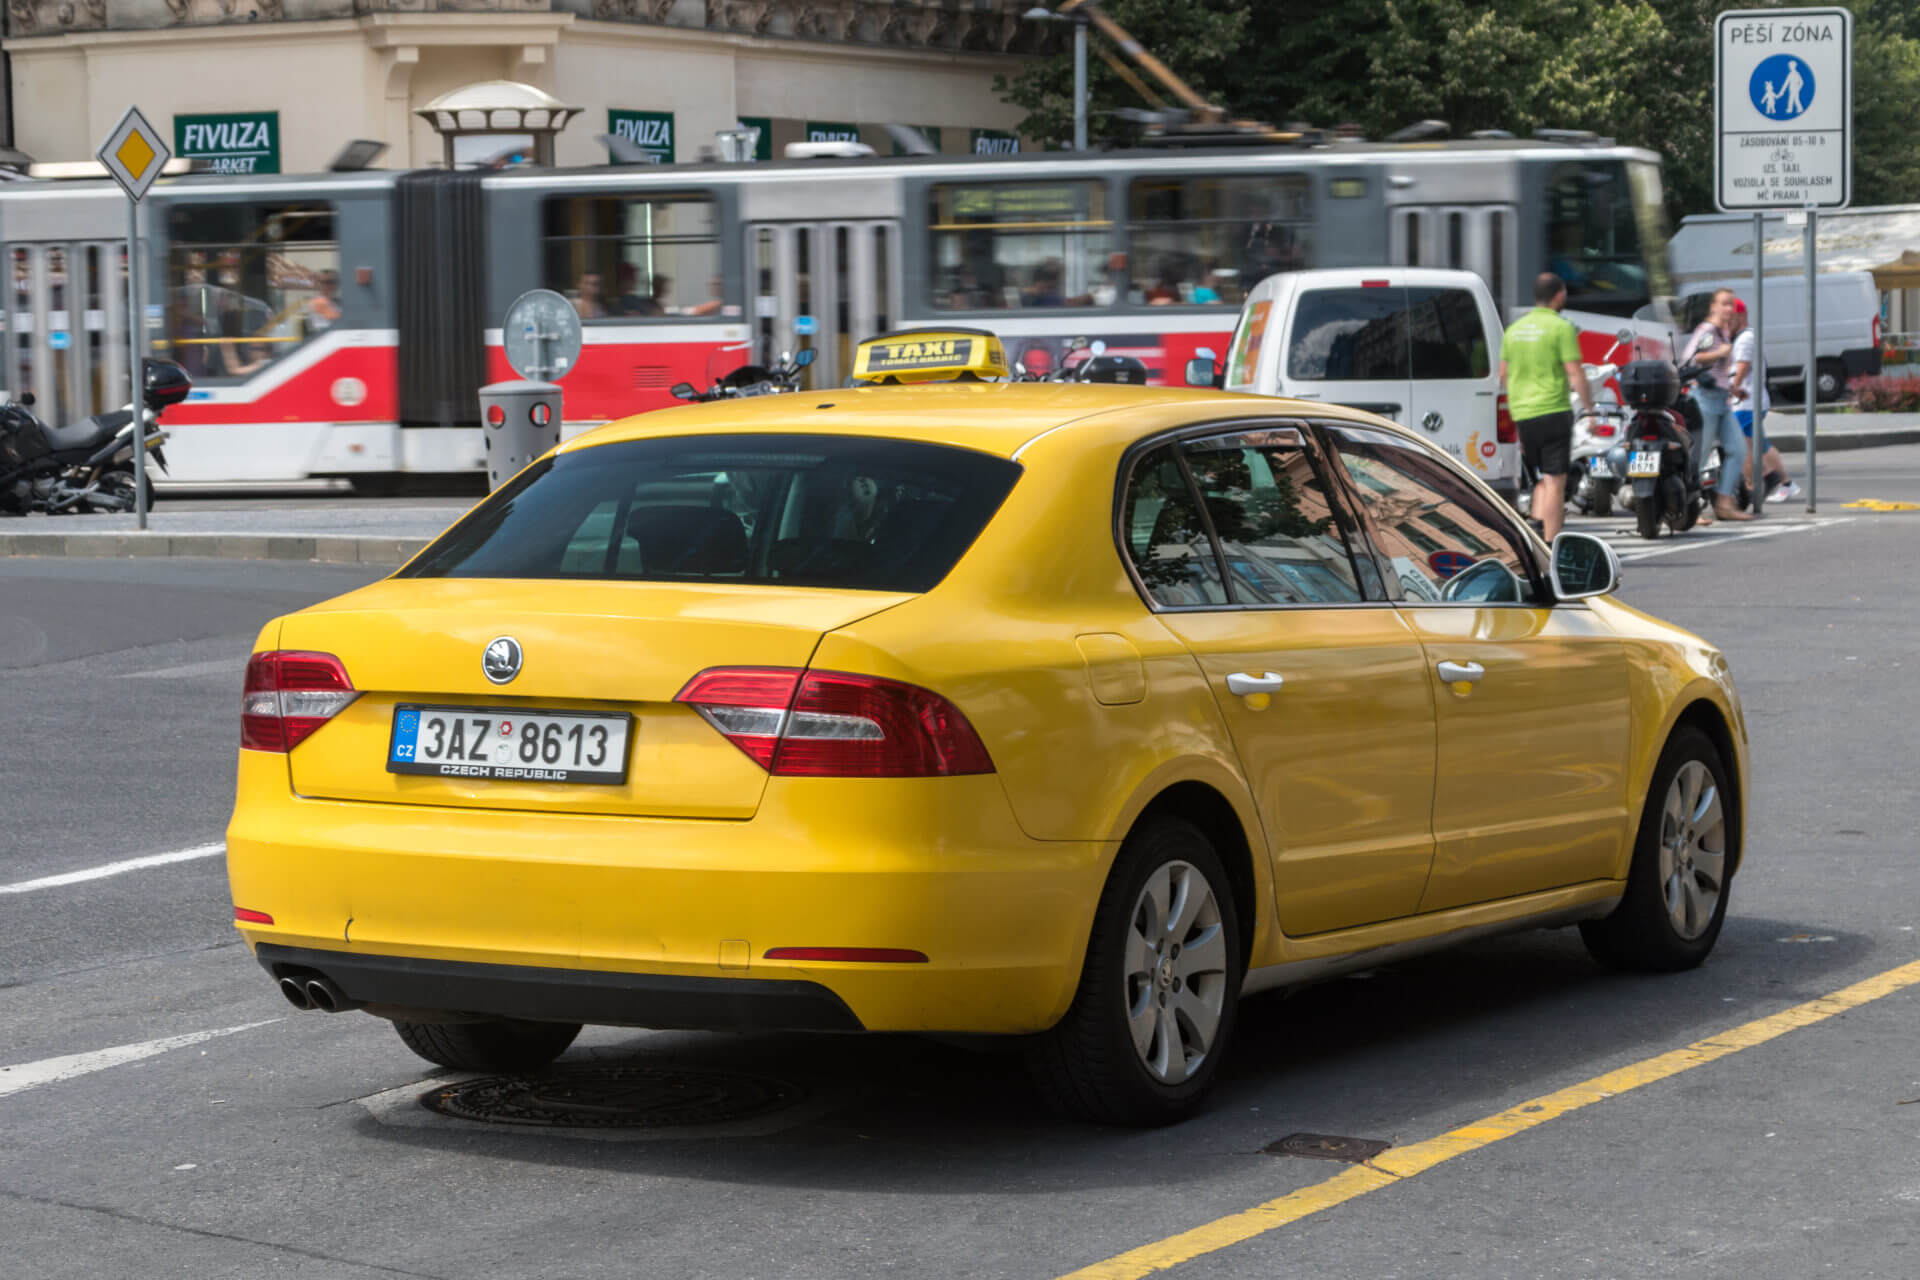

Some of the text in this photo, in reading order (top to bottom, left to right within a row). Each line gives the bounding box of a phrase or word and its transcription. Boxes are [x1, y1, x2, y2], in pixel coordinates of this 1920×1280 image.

[1731, 21, 1834, 44] PĚŠÍ ZÓNA
[184, 121, 270, 150] FIVUZA
[211, 157, 257, 174] ARKET
[1770, 177, 1779, 187] SE
[1784, 175, 1833, 187] SOUHLASEM
[1773, 190, 1800, 200] PRAHA
[884, 341, 956, 359] TAXI
[396, 744, 414, 757] CZ
[424, 717, 609, 767] 3AZ 8613
[440, 764, 567, 780] CZECH REPUBLIC
